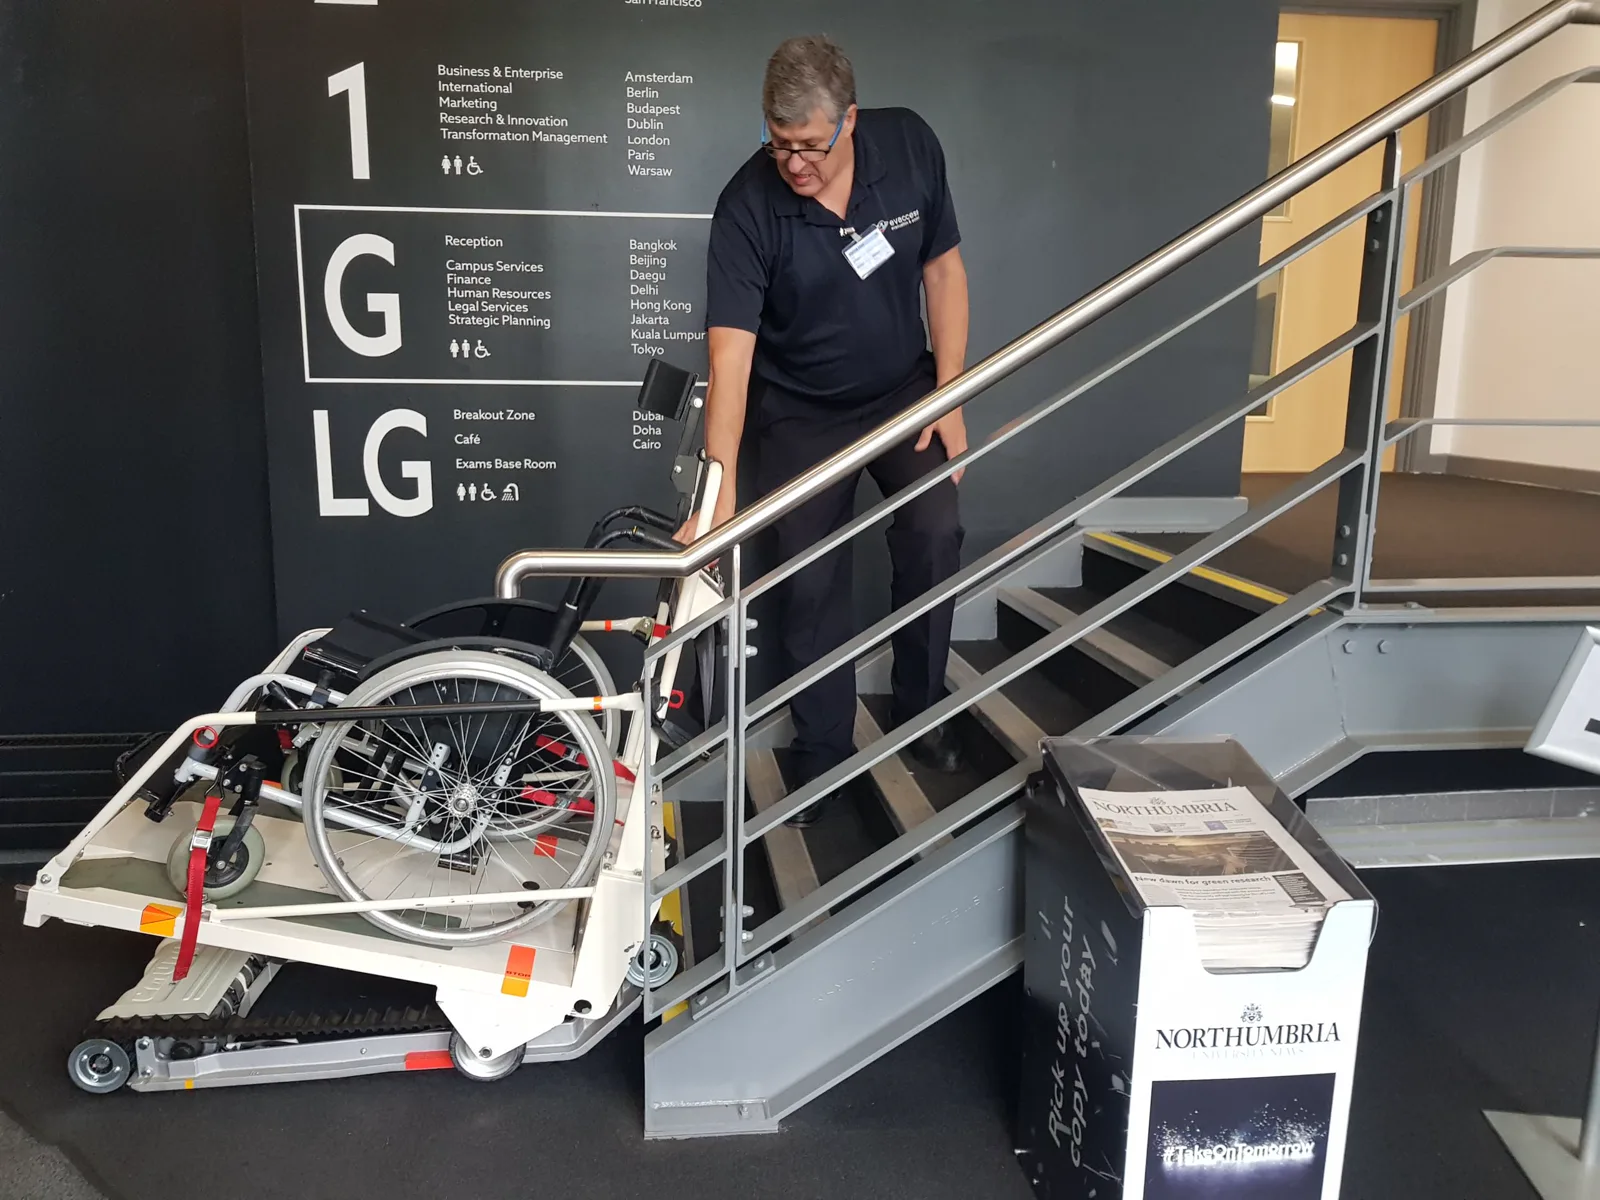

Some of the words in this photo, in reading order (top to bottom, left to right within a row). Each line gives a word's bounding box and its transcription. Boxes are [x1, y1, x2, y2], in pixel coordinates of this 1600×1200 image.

[437, 65, 491, 79] Business
[492, 66, 503, 79] &
[504, 67, 564, 82] Enterprise
[624, 71, 693, 84] Amsterdam
[438, 81, 513, 95] International
[626, 87, 659, 99] Berlin
[438, 96, 498, 112] Marketing
[626, 102, 681, 117] Budapest
[327, 61, 371, 180] 1
[439, 112, 494, 126] Research
[495, 114, 506, 126] &
[507, 114, 569, 127] Innovation
[627, 117, 664, 131] Dublin
[439, 128, 530, 143] Transformation
[531, 131, 608, 147] Management
[627, 133, 671, 146] London
[627, 149, 655, 162] Paris
[627, 164, 673, 178] Warsaw
[444, 235, 504, 250] Reception
[629, 239, 678, 253] Bangkok
[445, 260, 495, 275] Campus
[495, 261, 544, 273] Services
[629, 254, 667, 269] Beijing
[446, 273, 492, 285] Finance
[630, 270, 666, 284] Daegu
[323, 233, 403, 358] G
[447, 287, 490, 299] Human
[491, 288, 552, 300] Resources
[630, 284, 659, 296] Delhi
[447, 301, 480, 315] Legal
[480, 301, 529, 314] Services
[630, 299, 661, 313] Hong
[663, 299, 692, 314] Kong
[448, 314, 500, 328] Strategic
[501, 314, 551, 330] Planning
[630, 313, 670, 325] Jakarta
[631, 328, 661, 341] Kuala
[663, 328, 706, 343] Lumpur
[630, 343, 665, 357] Tokyo
[453, 409, 505, 421] Breakout
[505, 410, 536, 421] Zone
[632, 410, 665, 422] Dubai
[632, 424, 662, 436] Doha
[454, 432, 481, 445] Café
[632, 438, 662, 450] Cairo
[312, 408, 434, 517] LG
[455, 459, 493, 470] Exams
[494, 459, 522, 470] Base
[523, 459, 557, 471] Room
[1093, 800, 1237, 817] NORTHUMBRIA
[1134, 876, 1157, 884] New
[1159, 876, 1184, 886] dawn
[1185, 877, 1200, 886] for
[1202, 878, 1229, 887] green
[1230, 875, 1271, 885] research
[1059, 896, 1074, 998] your
[1074, 935, 1097, 1058] today
[1057, 1002, 1071, 1054] up
[1155, 1022, 1341, 1050] NORTHUMBRIA
[1048, 1060, 1072, 1148] Pick
[1071, 1064, 1089, 1168] copy
[1163, 1141, 1316, 1166] #TakeOnTomorrow
